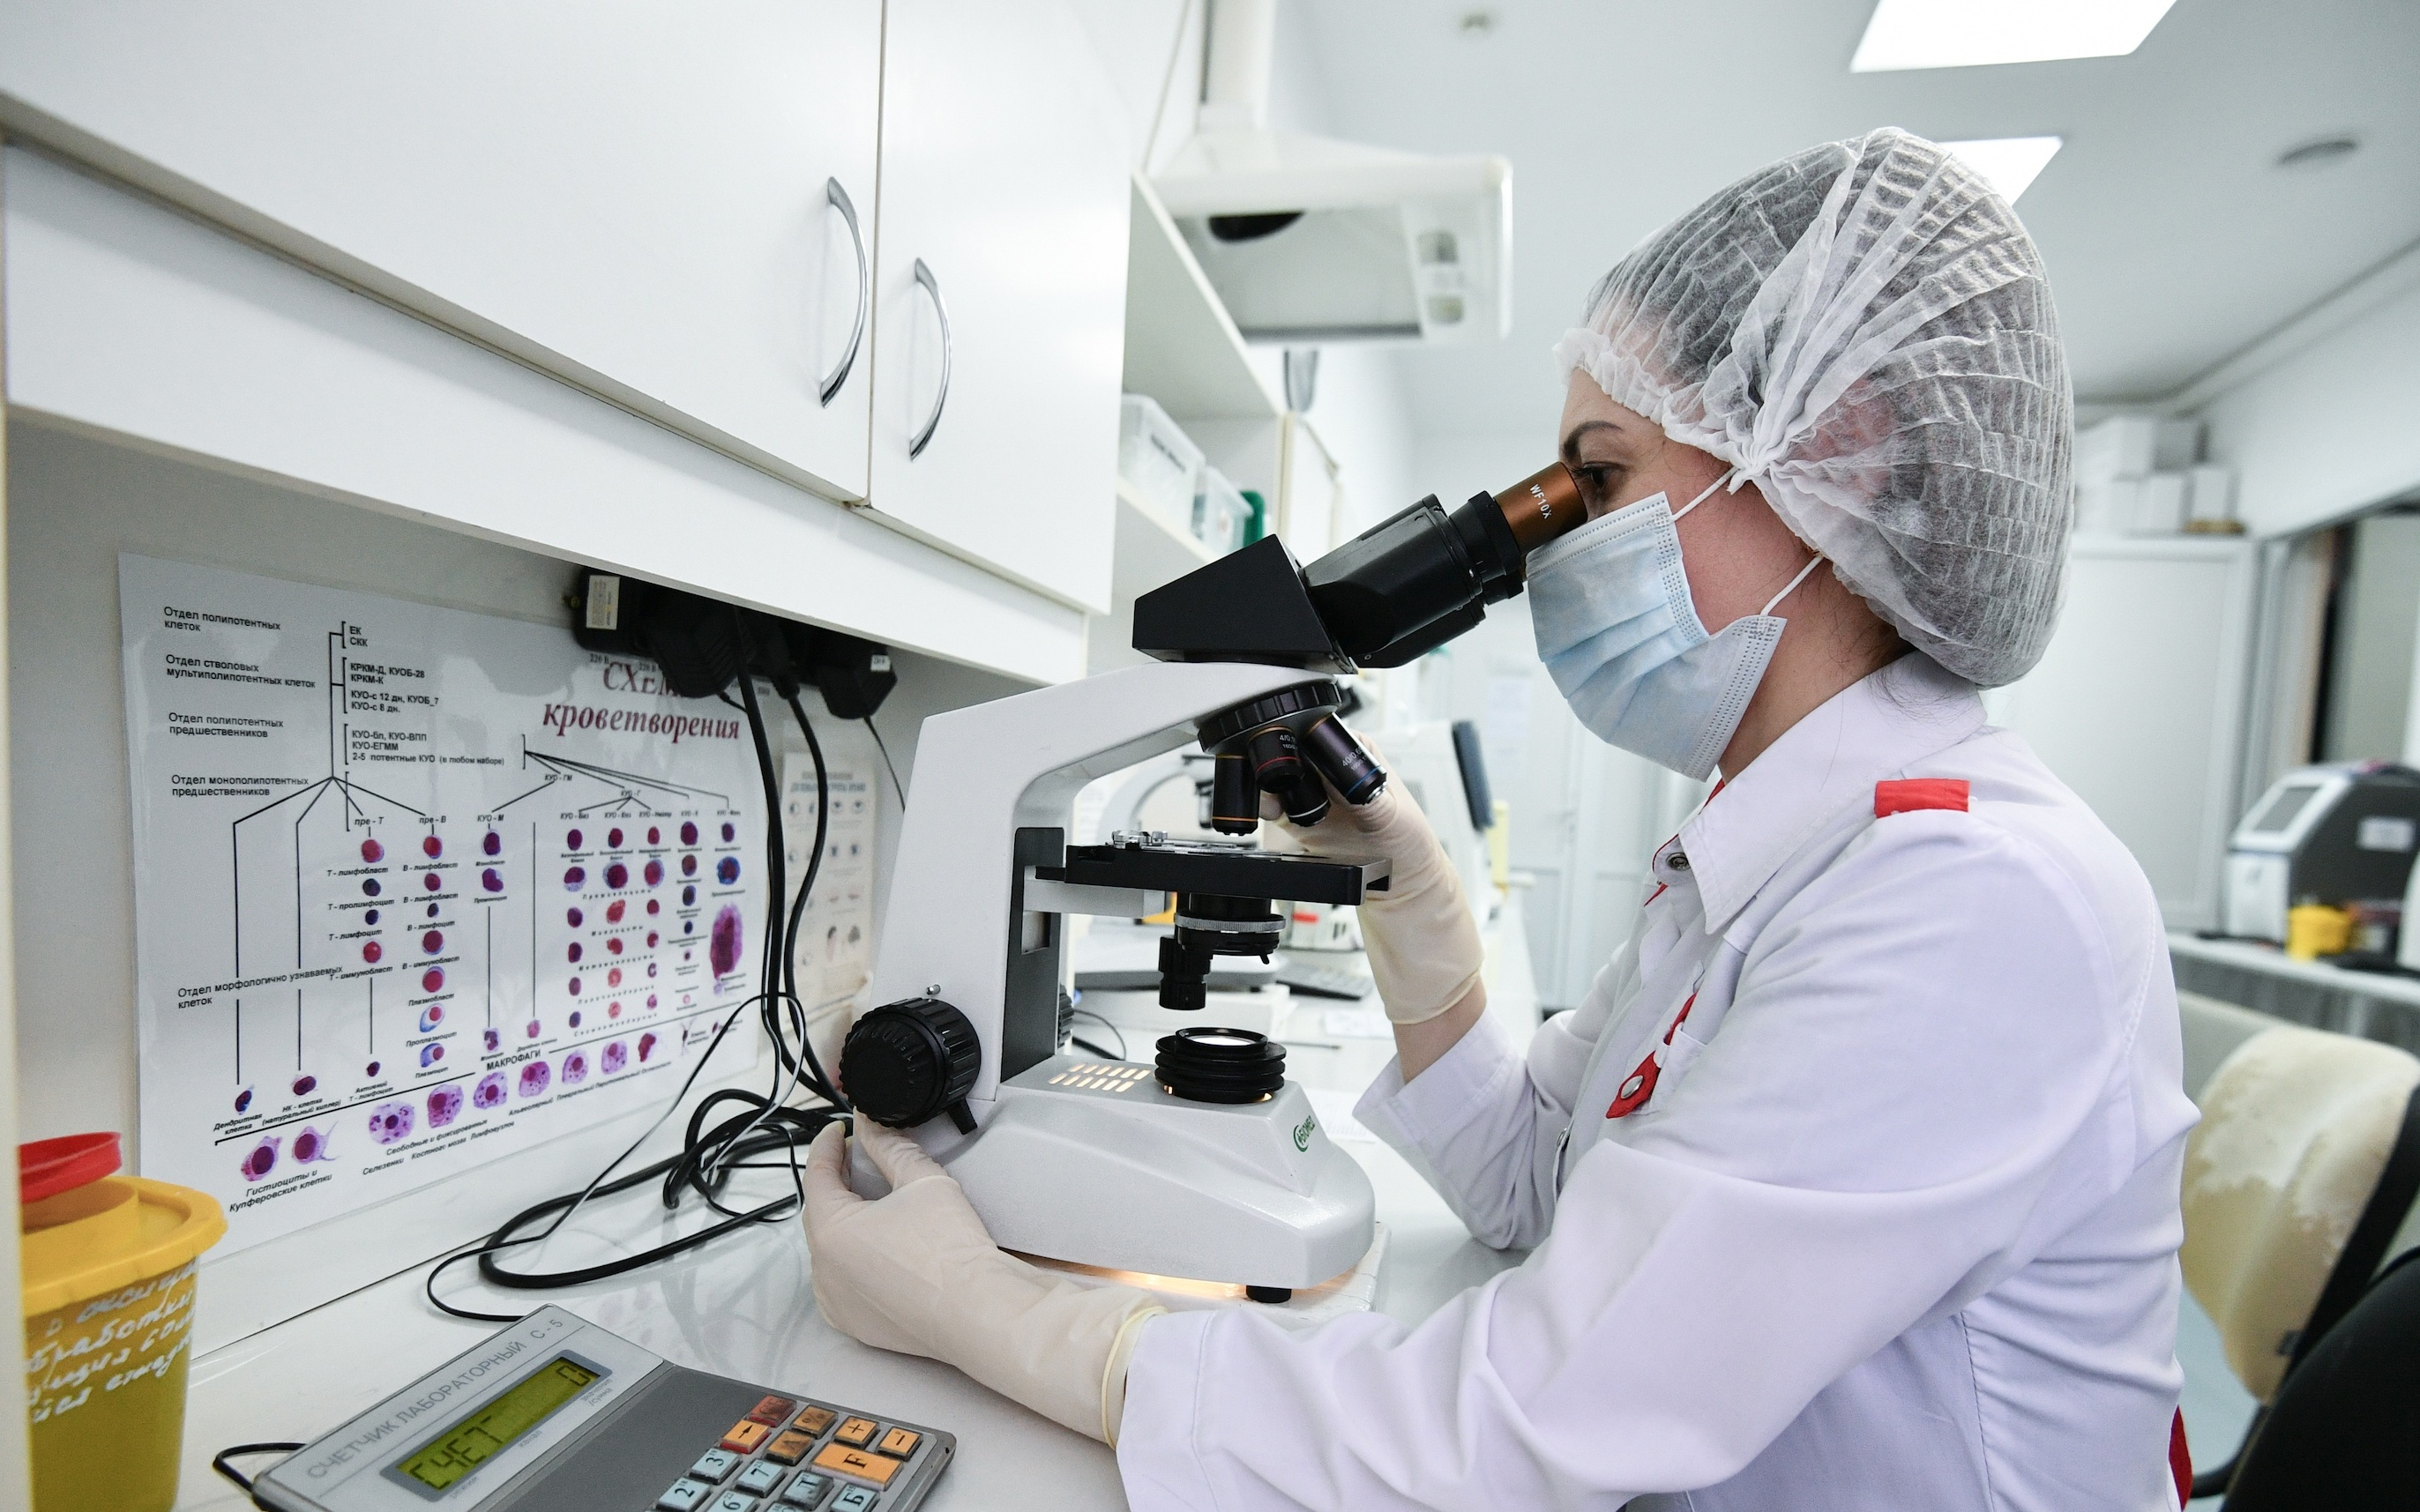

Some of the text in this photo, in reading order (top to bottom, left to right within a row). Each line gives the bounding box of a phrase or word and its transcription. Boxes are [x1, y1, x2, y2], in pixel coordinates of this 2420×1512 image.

[1529, 483, 1552, 519] WF10X
[164, 607, 281, 630] Отдел полипотентных
[164, 620, 201, 632] клеток
[349, 626, 362, 636] ЕК
[349, 637, 368, 647] СКК
[166, 654, 259, 672] Отдел стволовых
[350, 663, 425, 678] КРКМ-Д, КУОБ-28
[167, 668, 316, 689] мультиполипотентных клеток
[350, 674, 384, 685] КРКМ-К
[351, 690, 377, 700] КУО-с
[380, 693, 390, 702] 12
[392, 695, 405, 704] дн,
[351, 702, 377, 711] КУО-с
[386, 704, 400, 713] дн.
[168, 711, 284, 727] Отдел полипотентных
[542, 704, 740, 744] кроветворения
[169, 726, 268, 738] предшественников
[389, 731, 427, 741] КУО-ВПП
[353, 741, 399, 751] КУО-ЕГММ
[353, 752, 366, 761] 2-5
[477, 756, 504, 765] наборе)
[171, 774, 309, 786] Отдел монополипотентных
[172, 787, 270, 798] предшественников
[355, 818, 370, 827] пре
[338, 867, 388, 877] лимфобласт
[414, 861, 459, 871] лимфобласт
[339, 899, 394, 910] пролимфоцит
[414, 893, 459, 904] лимфобласт
[418, 920, 455, 930] лимфоцит
[340, 929, 383, 940] лимфоцит
[413, 956, 459, 968] иммунобласт
[340, 965, 393, 979] иммунобласт
[177, 965, 343, 998] Отдел морфологично узнаваемых
[178, 996, 213, 1009] клеток
[408, 993, 455, 1007] Плазмобласт
[406, 1032, 457, 1047] Проплазмоцит
[487, 1049, 542, 1071] МАКРОФАГИ
[415, 1067, 449, 1079] Плазмоцит
[358, 1087, 394, 1100] лимфоцит
[298, 1098, 323, 1109] клетка
[262, 1099, 341, 1127] (натуральный киллер)
[213, 1113, 263, 1132] Дендритная
[224, 1122, 253, 1136] клетка
[386, 1138, 429, 1156] Свободные
[436, 1119, 488, 1141] фиксированные
[411, 1136, 467, 1160] Костного мозга
[362, 1158, 405, 1175] Селезенки
[245, 1172, 310, 1197] Гистиоциты
[229, 1173, 332, 1213] Купферовские клетки
[556, 1365, 591, 1387] 0
[308, 1420, 400, 1479] СЧЕТЧИК
[397, 1340, 527, 1425] ЛАБОРАТОРНЫЙ
[410, 1415, 503, 1490] СЧЕТ
[706, 1456, 724, 1467] 3
[843, 1453, 868, 1469] F
[751, 1468, 770, 1477] 7
[675, 1487, 696, 1498] 2
[722, 1501, 741, 1510] 6
[842, 1492, 864, 1507] Б
